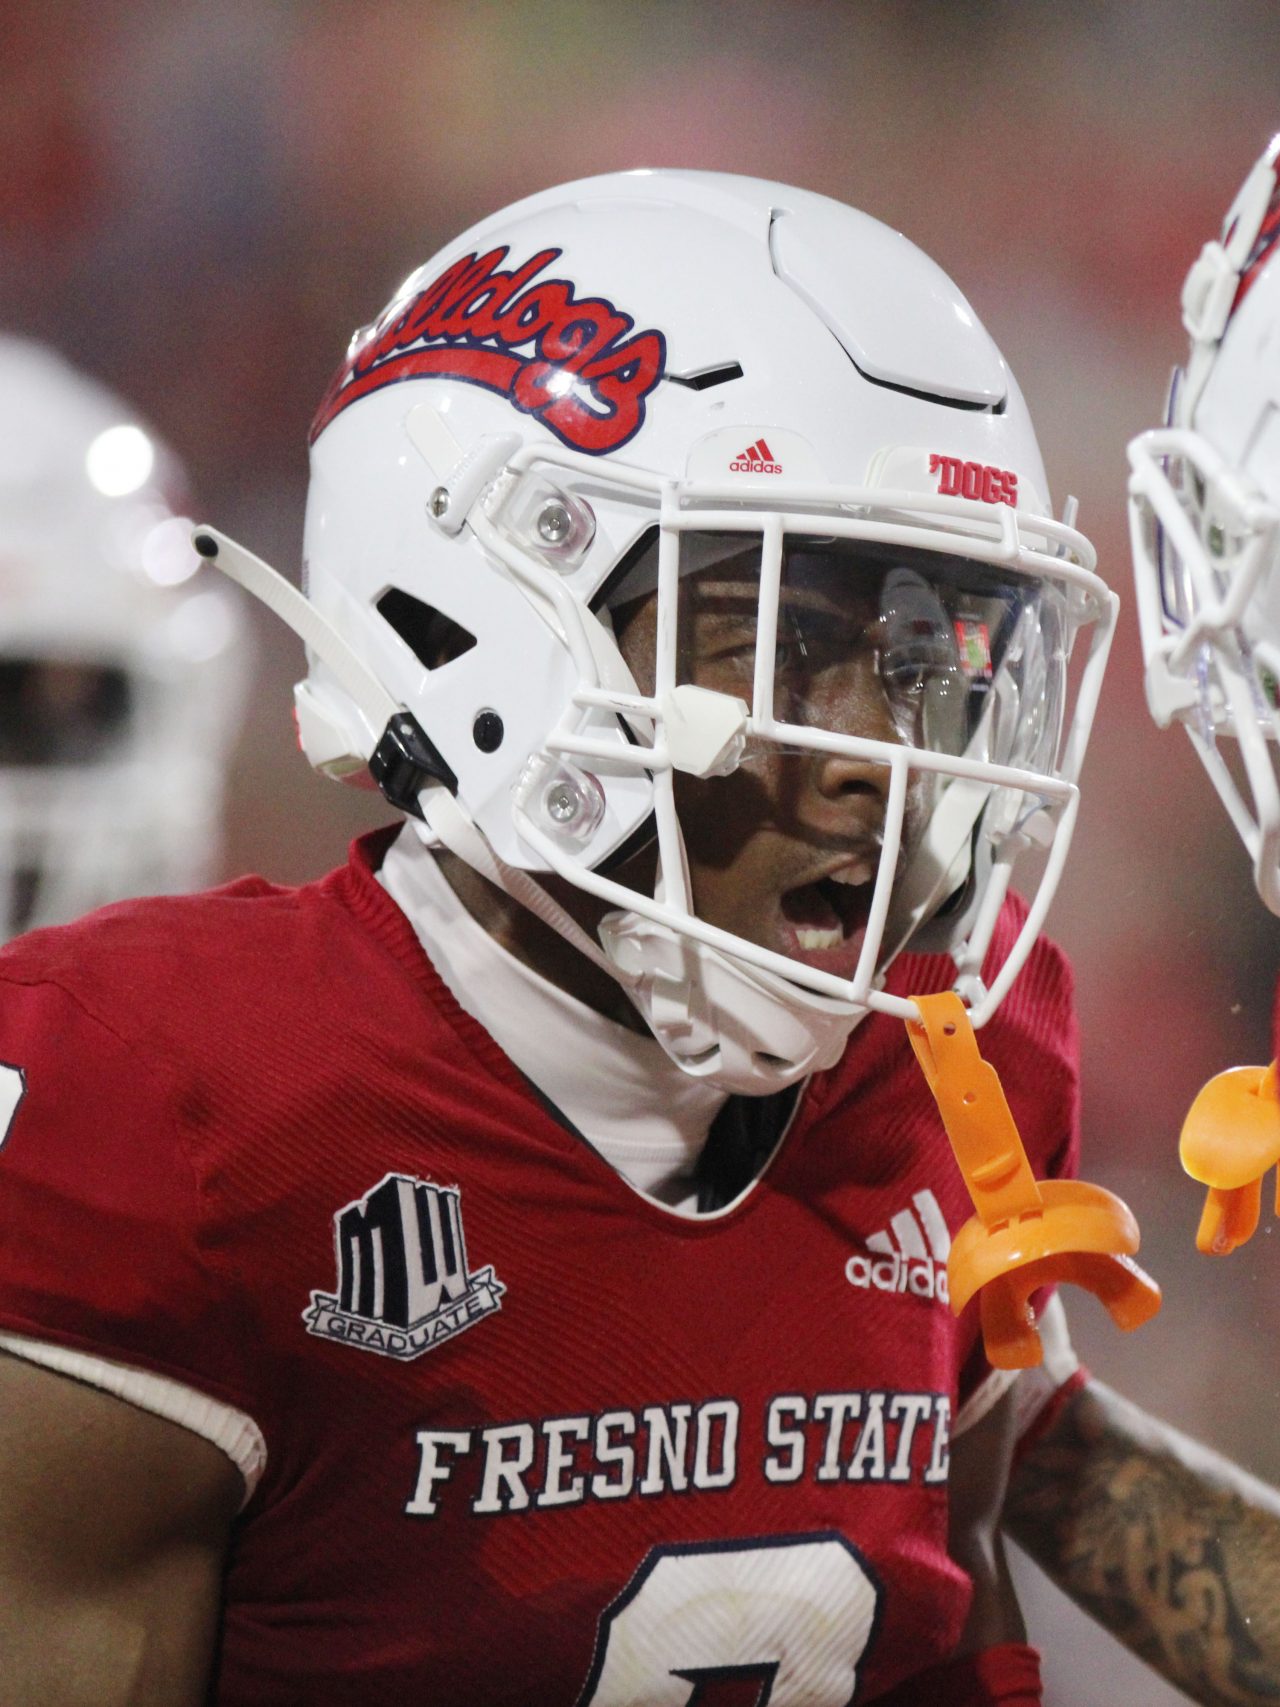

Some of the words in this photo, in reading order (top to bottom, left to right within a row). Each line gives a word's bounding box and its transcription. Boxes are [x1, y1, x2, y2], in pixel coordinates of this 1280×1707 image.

[729, 459, 783, 475] adidas
[929, 453, 1018, 508] 'DOGS
[845, 1251, 950, 1305] adida
[326, 1295, 484, 1353] GRADUATE
[404, 1399, 742, 1517] FRESNO
